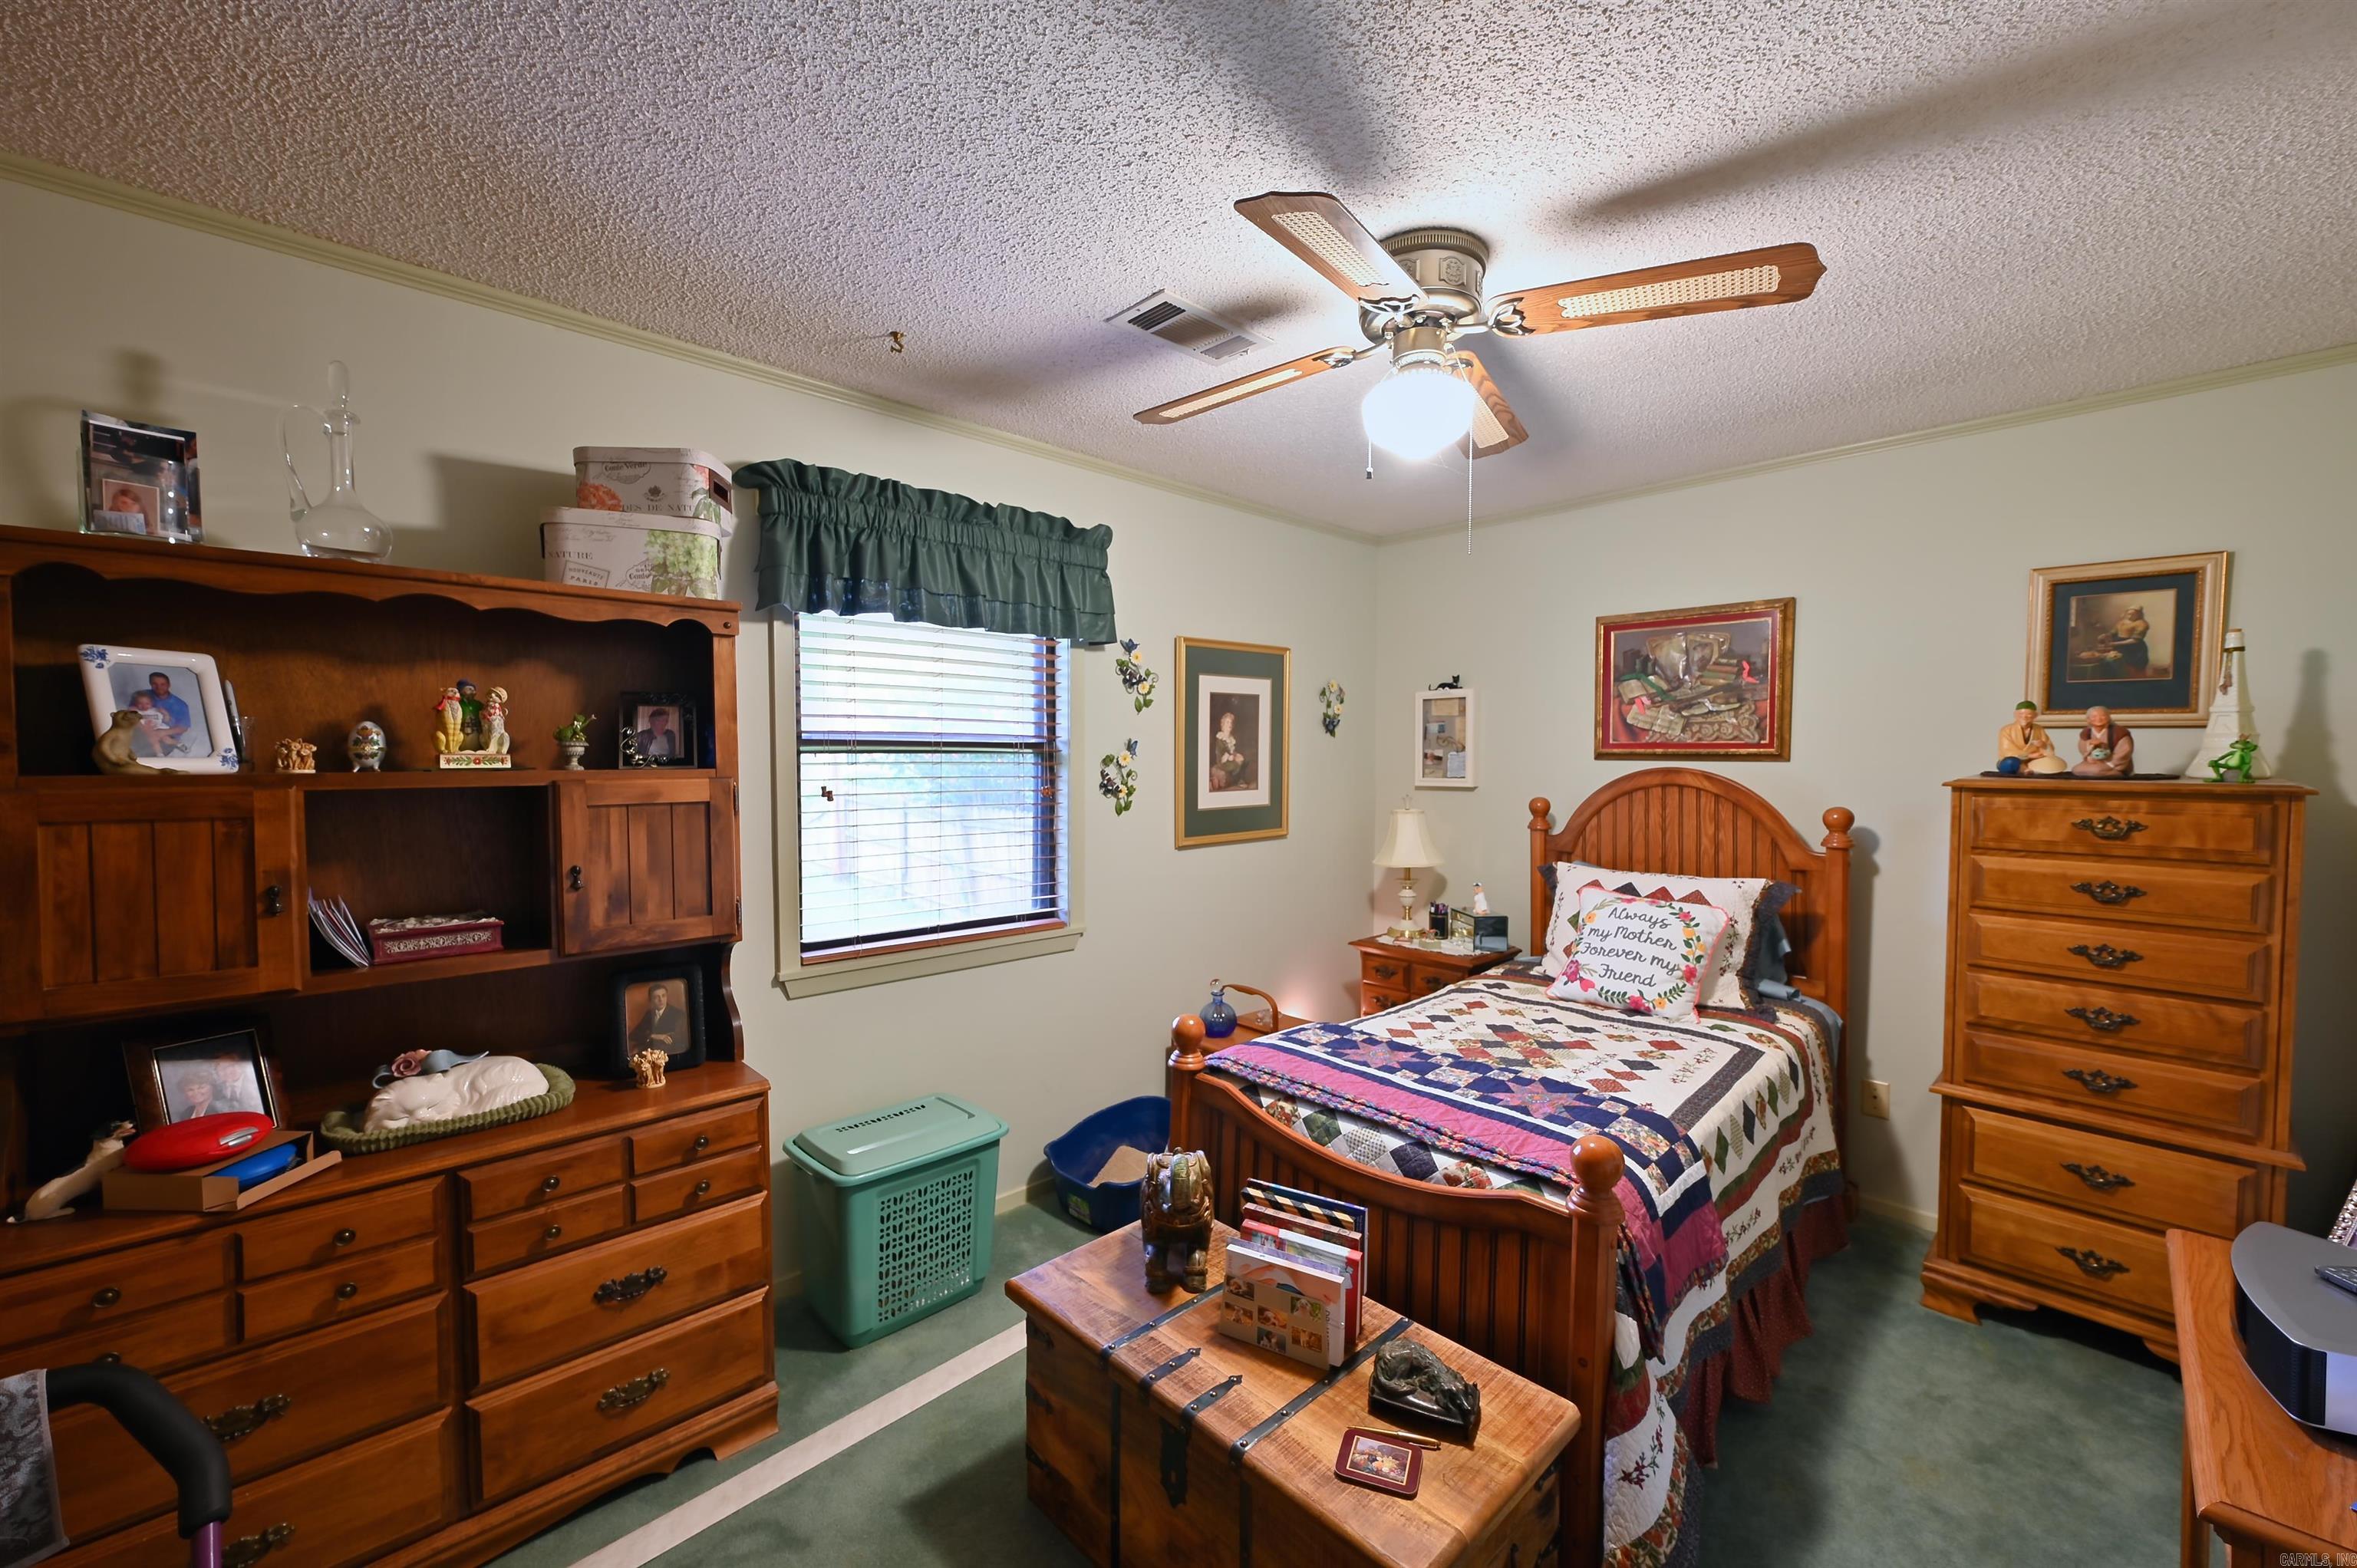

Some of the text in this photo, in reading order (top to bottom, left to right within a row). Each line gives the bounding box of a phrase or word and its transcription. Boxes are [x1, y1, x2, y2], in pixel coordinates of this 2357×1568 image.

[547, 551, 594, 560] NATURE
[570, 575, 598, 586] PARIS
[1608, 907, 1672, 929] Always
[1587, 926, 1677, 950] my Mother
[1581, 942, 1678, 976] Forever my
[1598, 964, 1656, 987] Friend
